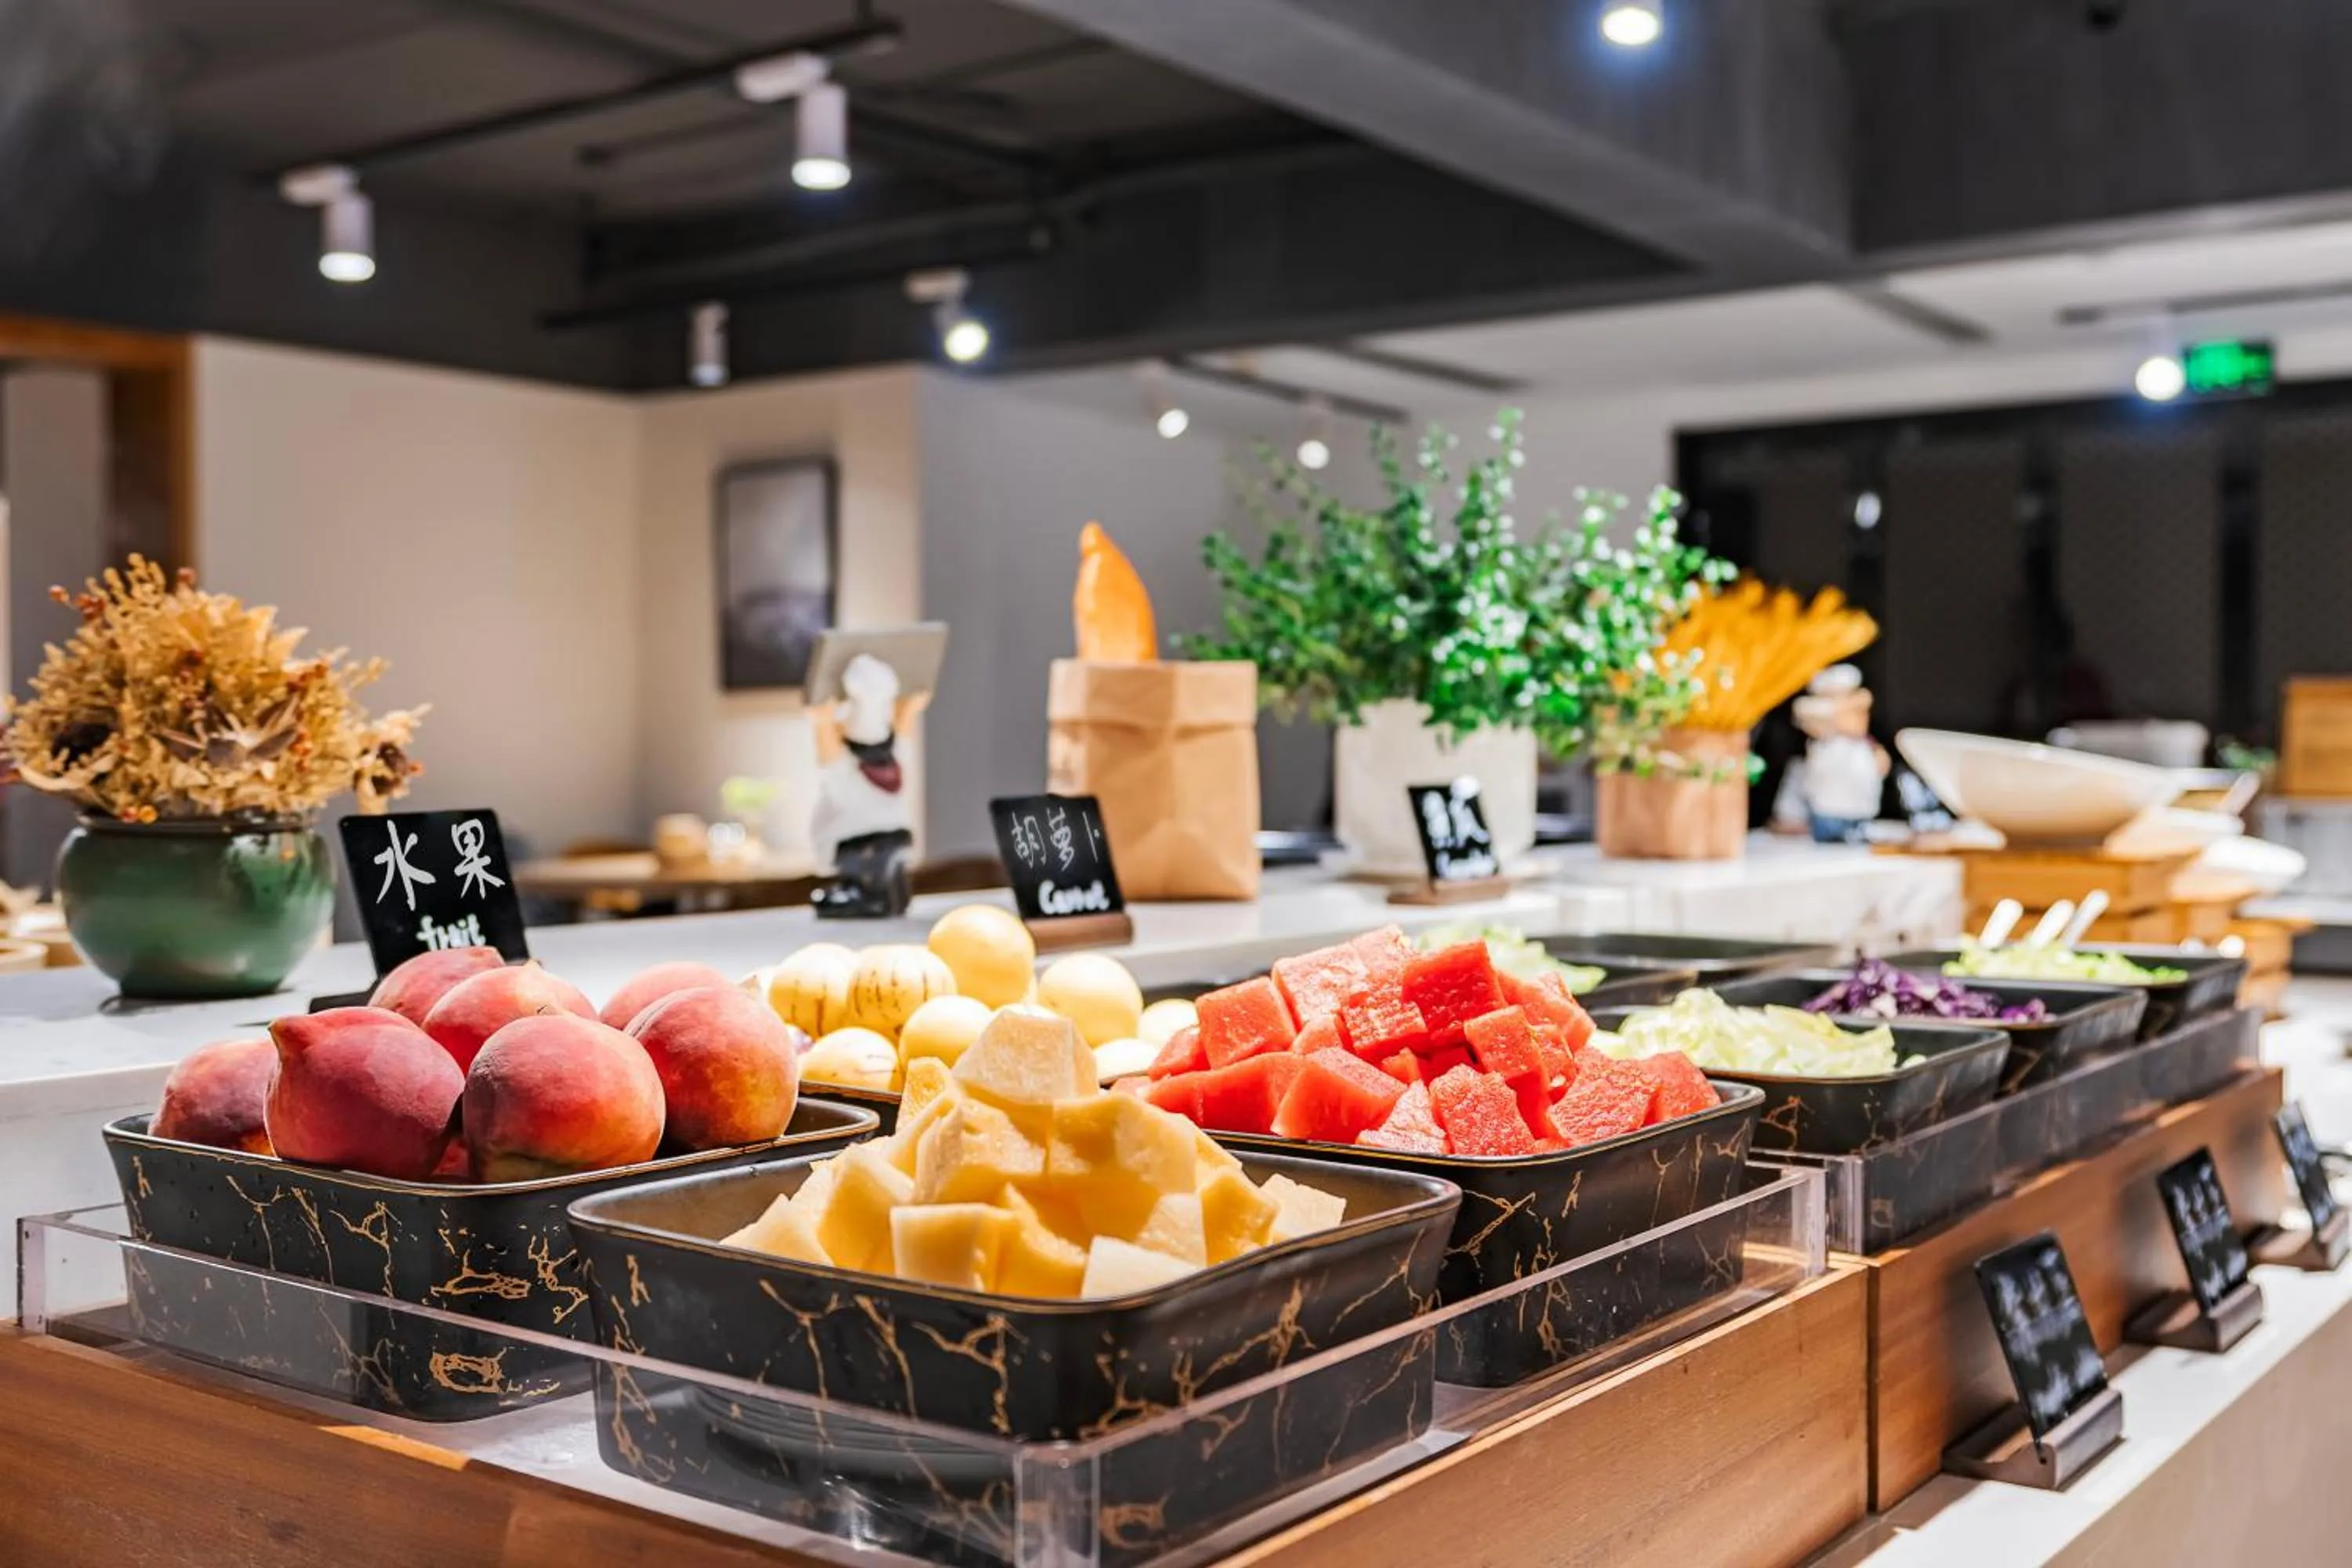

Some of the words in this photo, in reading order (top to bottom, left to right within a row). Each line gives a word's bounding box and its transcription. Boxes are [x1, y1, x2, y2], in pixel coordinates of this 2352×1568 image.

[374, 818, 506, 912] 水果
[1010, 806, 1100, 872] 胡萝卜
[416, 913, 486, 950] fruit
